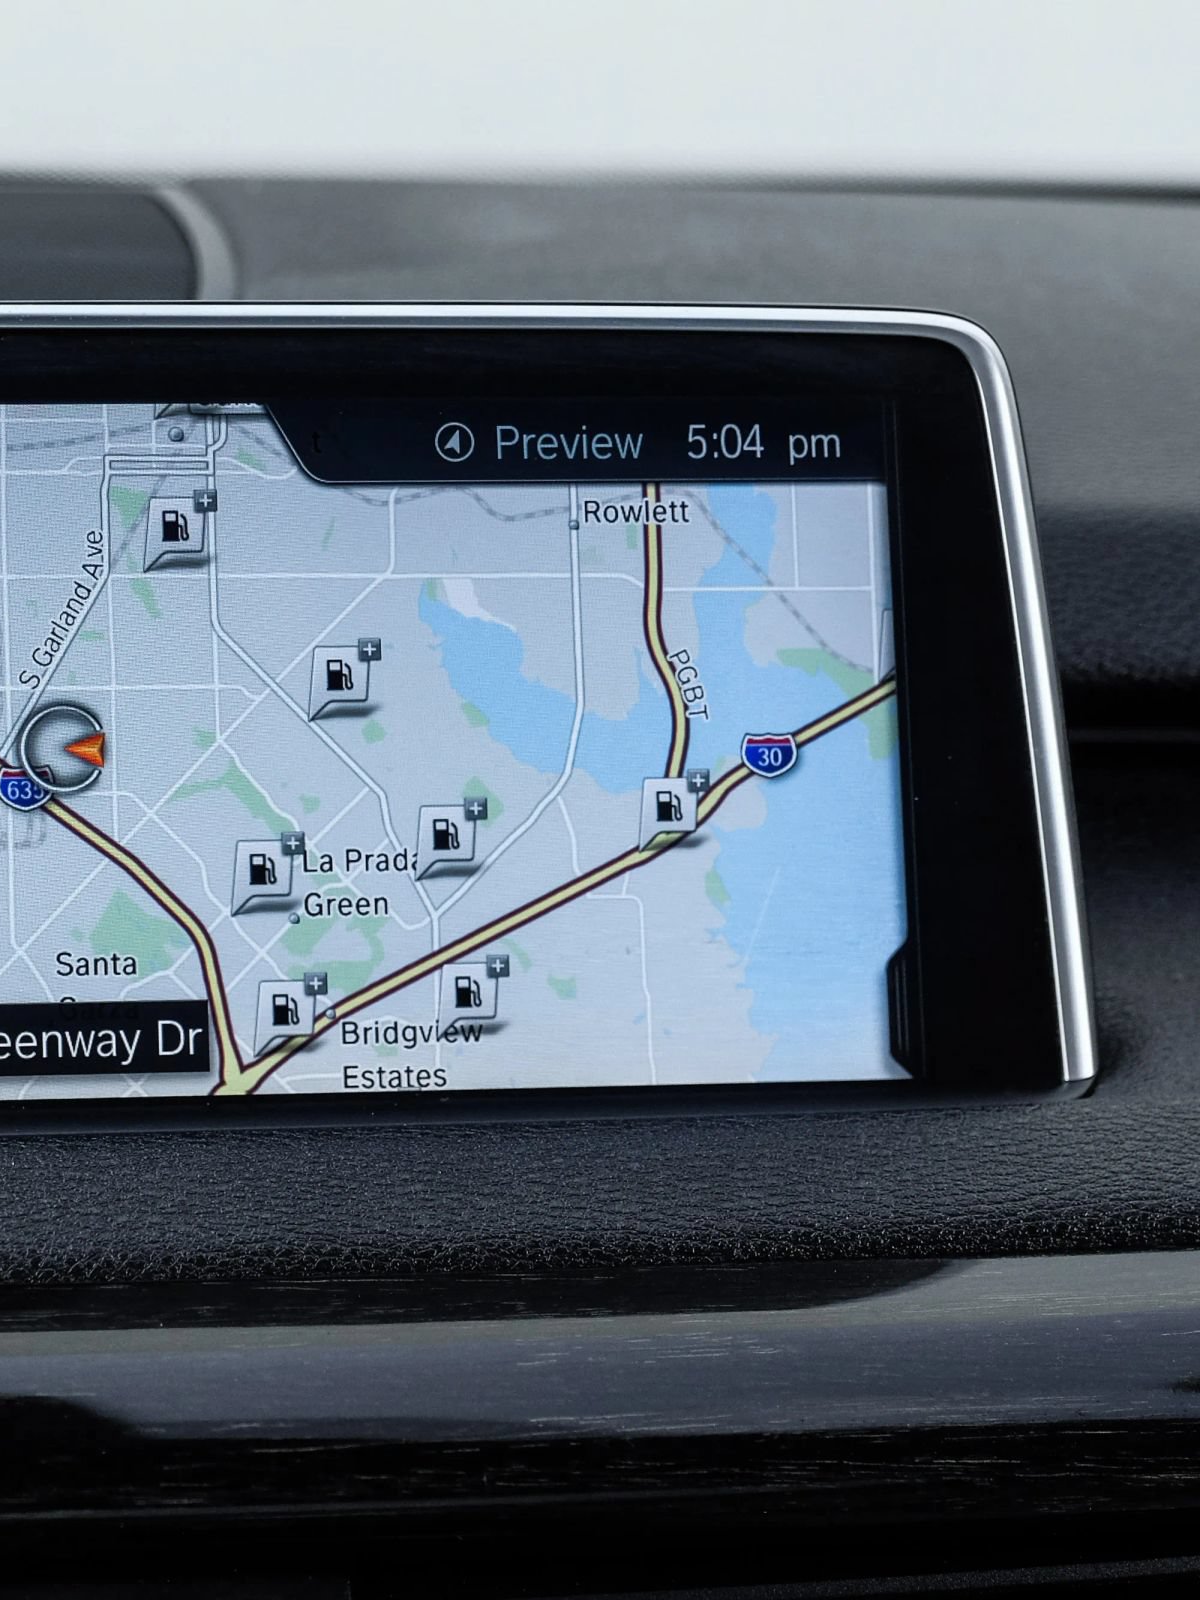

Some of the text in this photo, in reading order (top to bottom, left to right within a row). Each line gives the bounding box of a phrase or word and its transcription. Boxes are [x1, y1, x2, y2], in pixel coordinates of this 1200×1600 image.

[496, 425, 643, 460] Preview
[687, 423, 841, 466] 5:04 pm
[584, 500, 689, 524] Rowlett
[19, 530, 103, 690] S Garland Ave
[669, 649, 709, 720] PGBT
[758, 748, 782, 766] 30
[303, 850, 333, 873] La
[304, 892, 389, 917] Green
[56, 952, 137, 976] Santa
[158, 1020, 202, 1056] Dr
[341, 1020, 483, 1050] Bridgview
[343, 1065, 447, 1089] Estates
